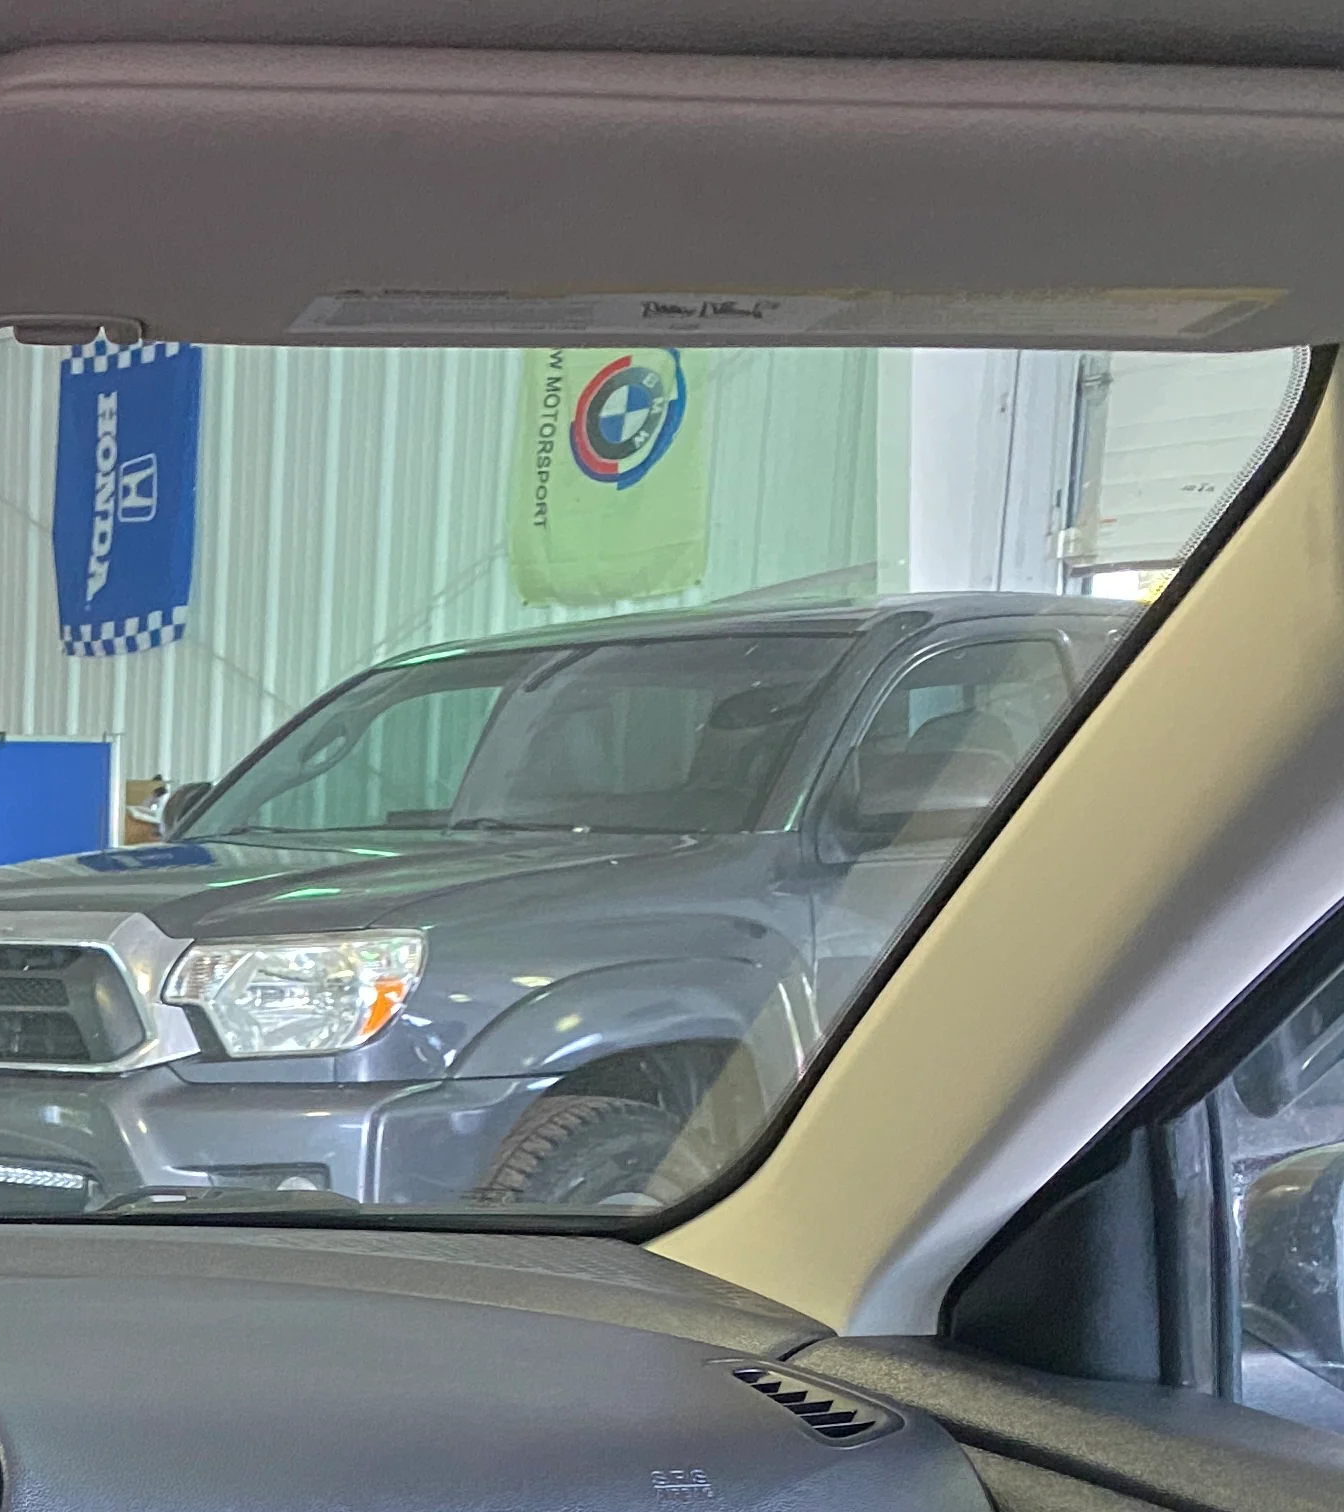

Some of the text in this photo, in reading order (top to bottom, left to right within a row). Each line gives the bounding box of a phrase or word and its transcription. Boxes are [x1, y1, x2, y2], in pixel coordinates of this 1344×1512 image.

[533, 376, 564, 529] MOTORSPORT
[633, 373, 664, 449] BMW
[86, 391, 118, 602] HONDA
